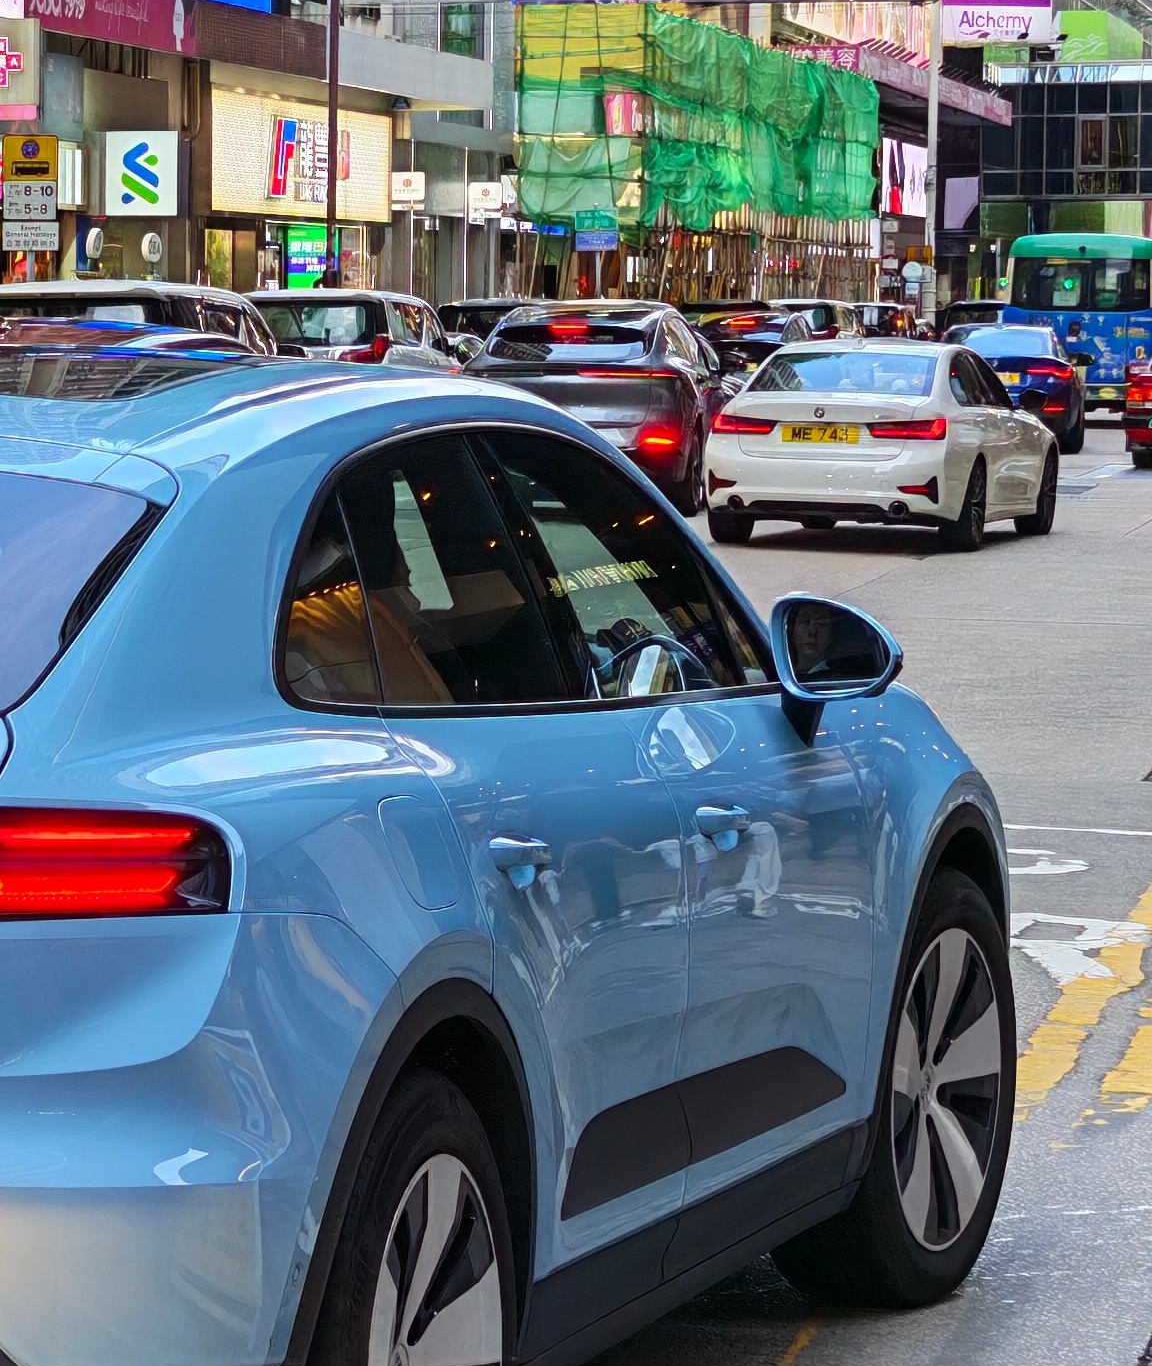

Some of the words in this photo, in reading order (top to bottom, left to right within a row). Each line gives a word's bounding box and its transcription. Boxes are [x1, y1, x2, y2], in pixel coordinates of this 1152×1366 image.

[958, 10, 1033, 33] Alchemy
[23, 185, 54, 197] 8-10
[24, 203, 48, 215] 5-8
[791, 426, 813, 441] ME
